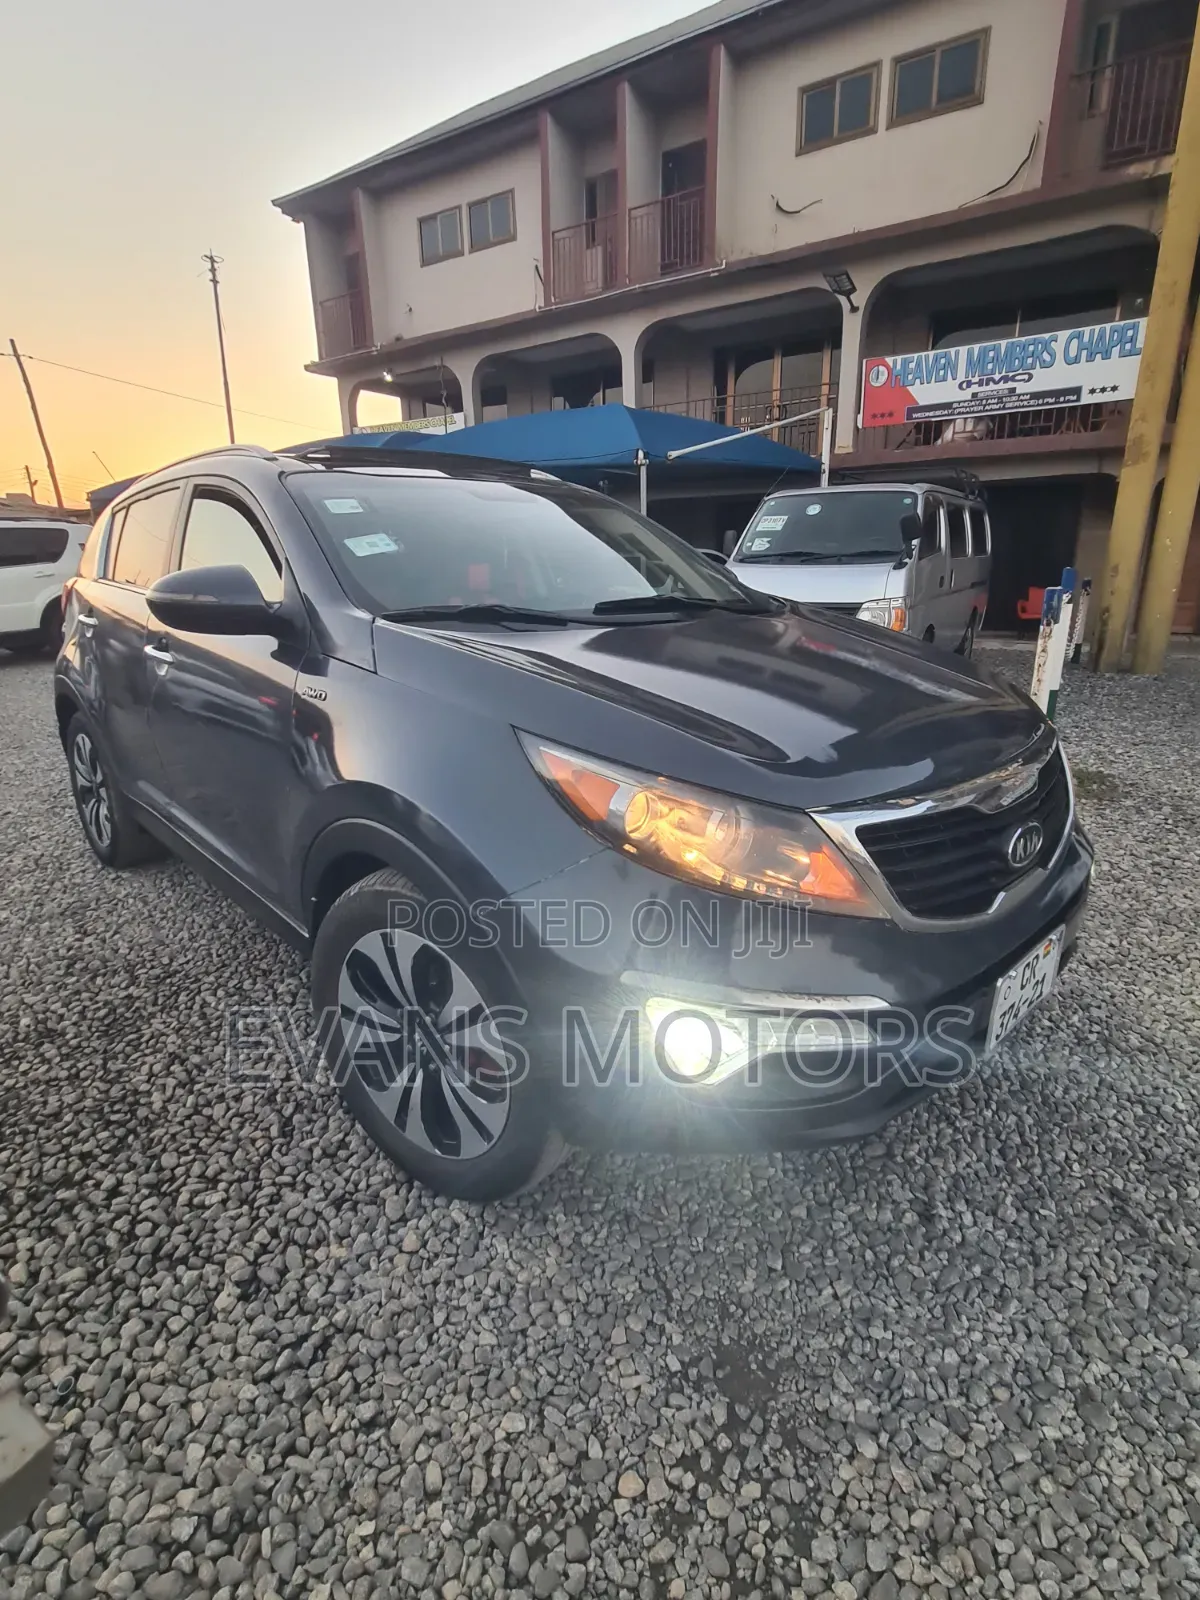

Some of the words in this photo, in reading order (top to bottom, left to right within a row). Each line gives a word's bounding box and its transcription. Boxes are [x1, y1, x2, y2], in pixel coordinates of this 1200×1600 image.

[891, 350, 959, 387] HEAVEN
[965, 334, 1058, 377] MEMBERS
[1063, 321, 1142, 365] CHAPEL
[301, 686, 327, 701] AWD
[1020, 953, 1040, 991] CR
